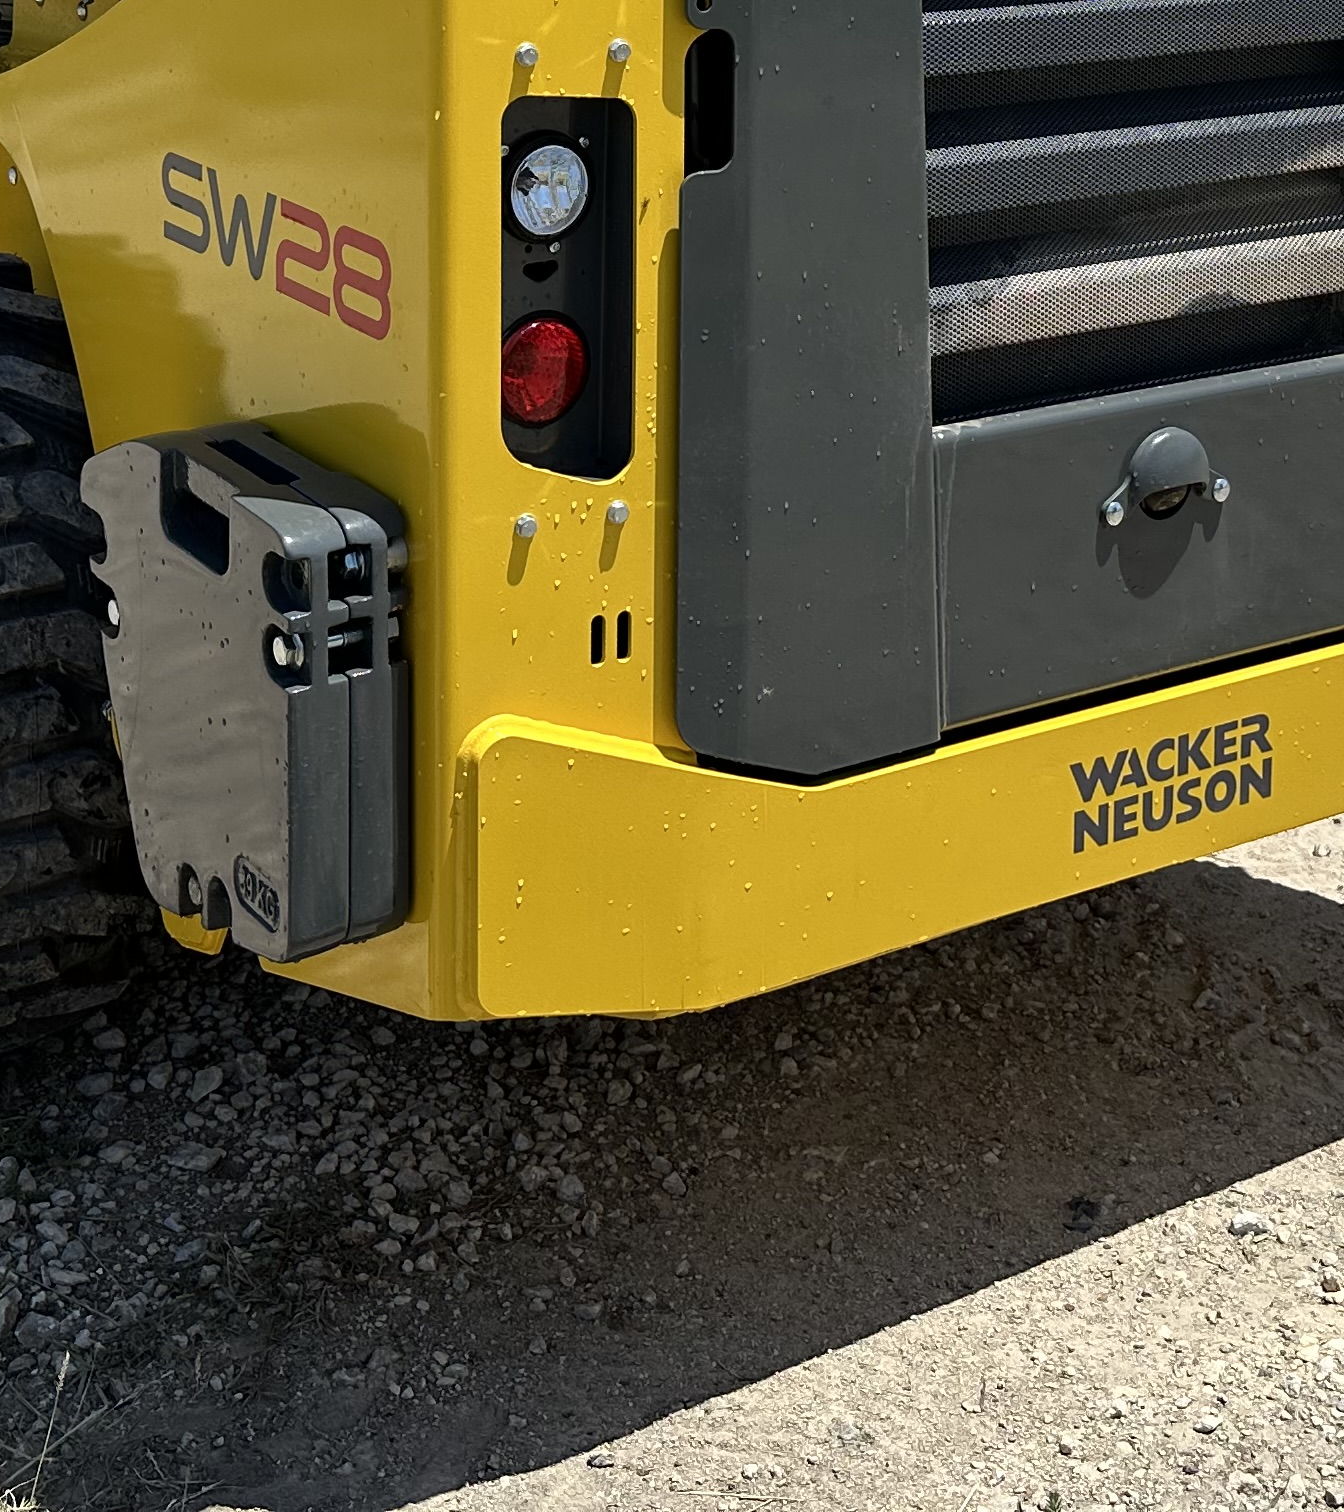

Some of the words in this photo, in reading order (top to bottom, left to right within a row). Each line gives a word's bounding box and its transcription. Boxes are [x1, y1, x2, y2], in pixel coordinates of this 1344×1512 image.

[161, 151, 392, 341] SW28
[1069, 714, 1273, 803] WACKER
[1073, 756, 1273, 854] NEUSON
